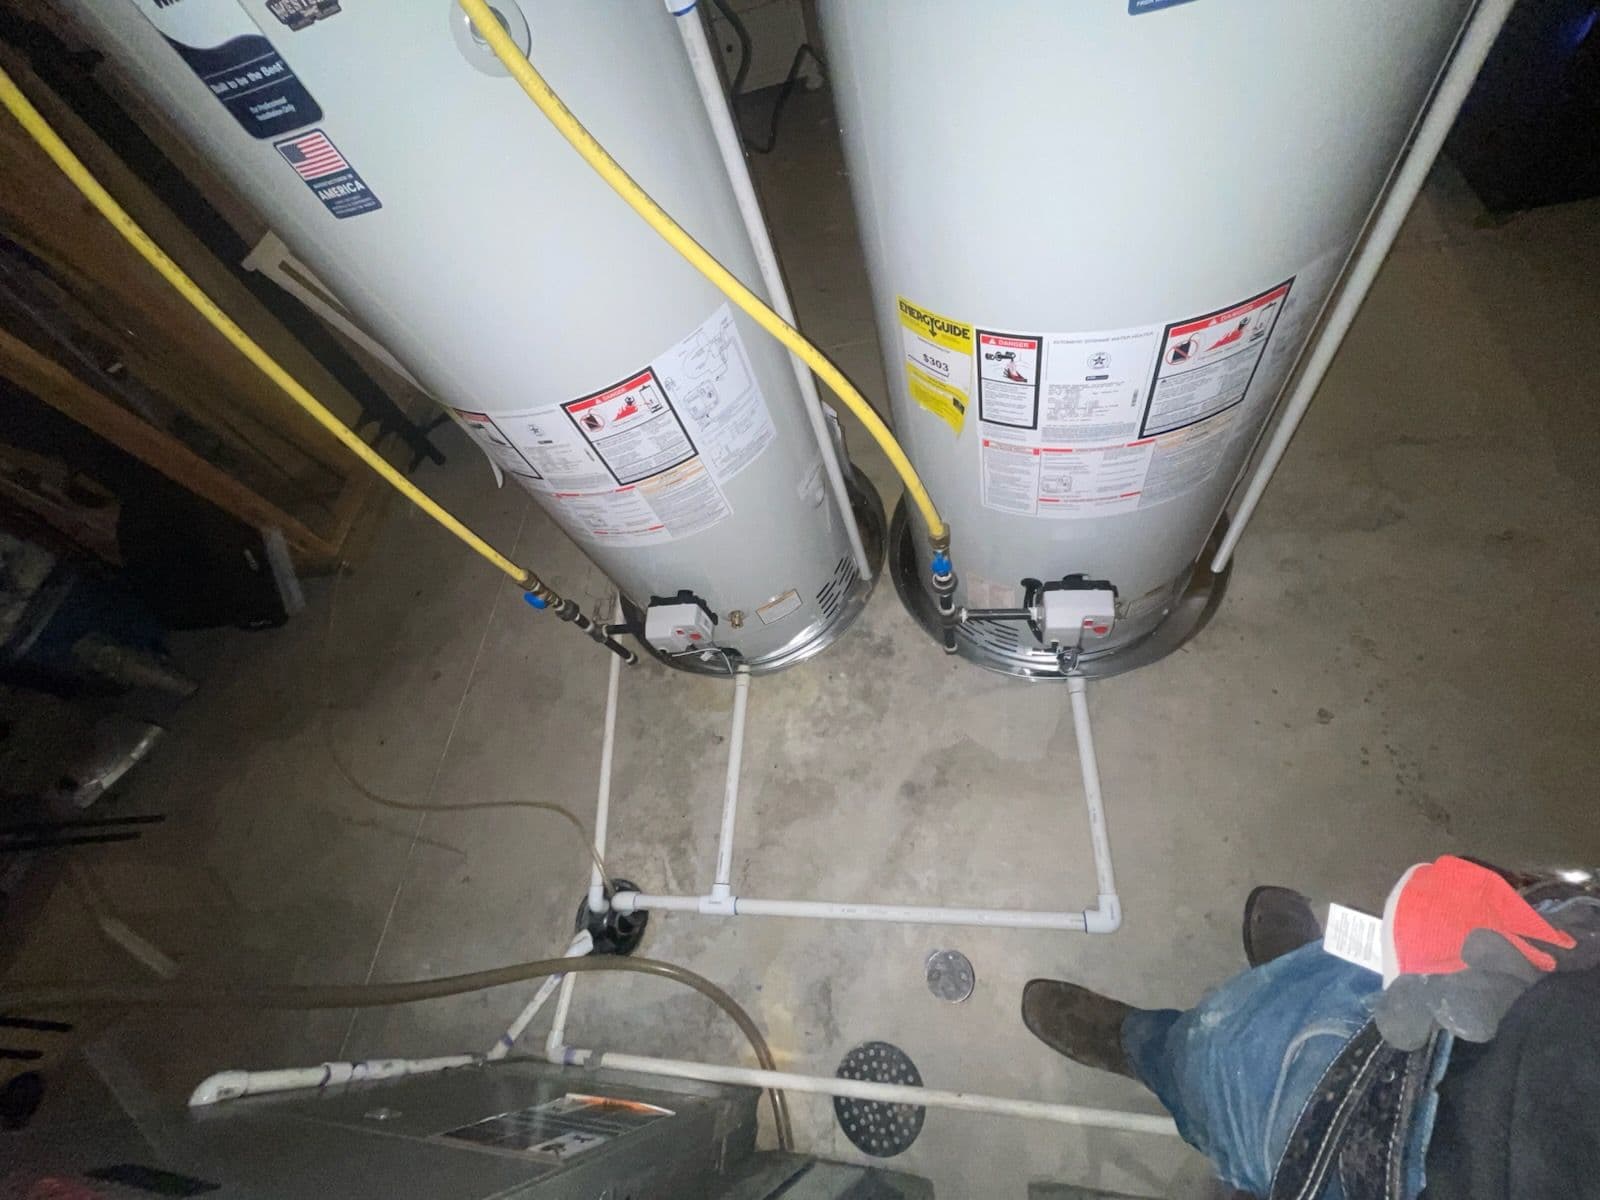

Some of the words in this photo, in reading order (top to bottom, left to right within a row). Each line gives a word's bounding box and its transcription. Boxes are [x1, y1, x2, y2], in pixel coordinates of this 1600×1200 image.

[317, 180, 366, 201] AMERICA
[998, 339, 1030, 349] DANGER
[923, 353, 949, 372] $303
